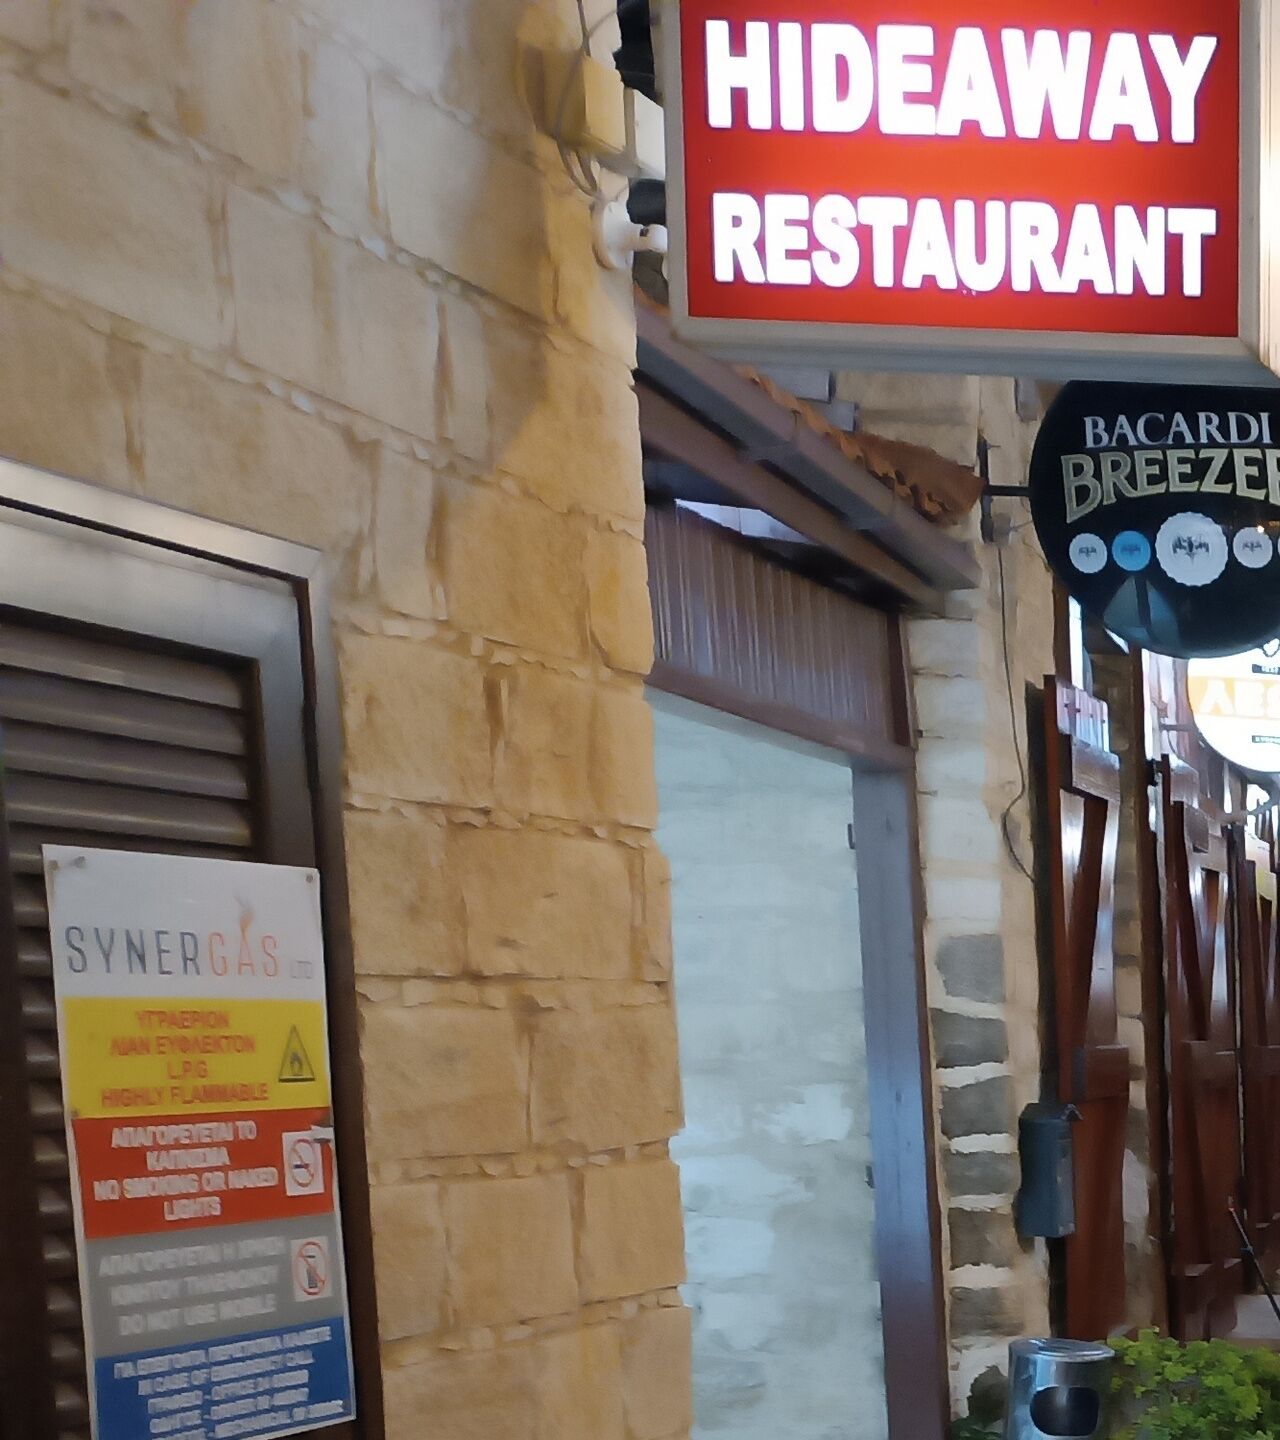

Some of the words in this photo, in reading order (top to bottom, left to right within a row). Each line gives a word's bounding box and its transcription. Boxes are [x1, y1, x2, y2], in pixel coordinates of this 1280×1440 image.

[705, 19, 1218, 143] HIDEAWAY
[712, 192, 1217, 297] RESTAURANT
[1083, 411, 1274, 449] BACARDI
[65, 925, 278, 977] SYNERGAS
